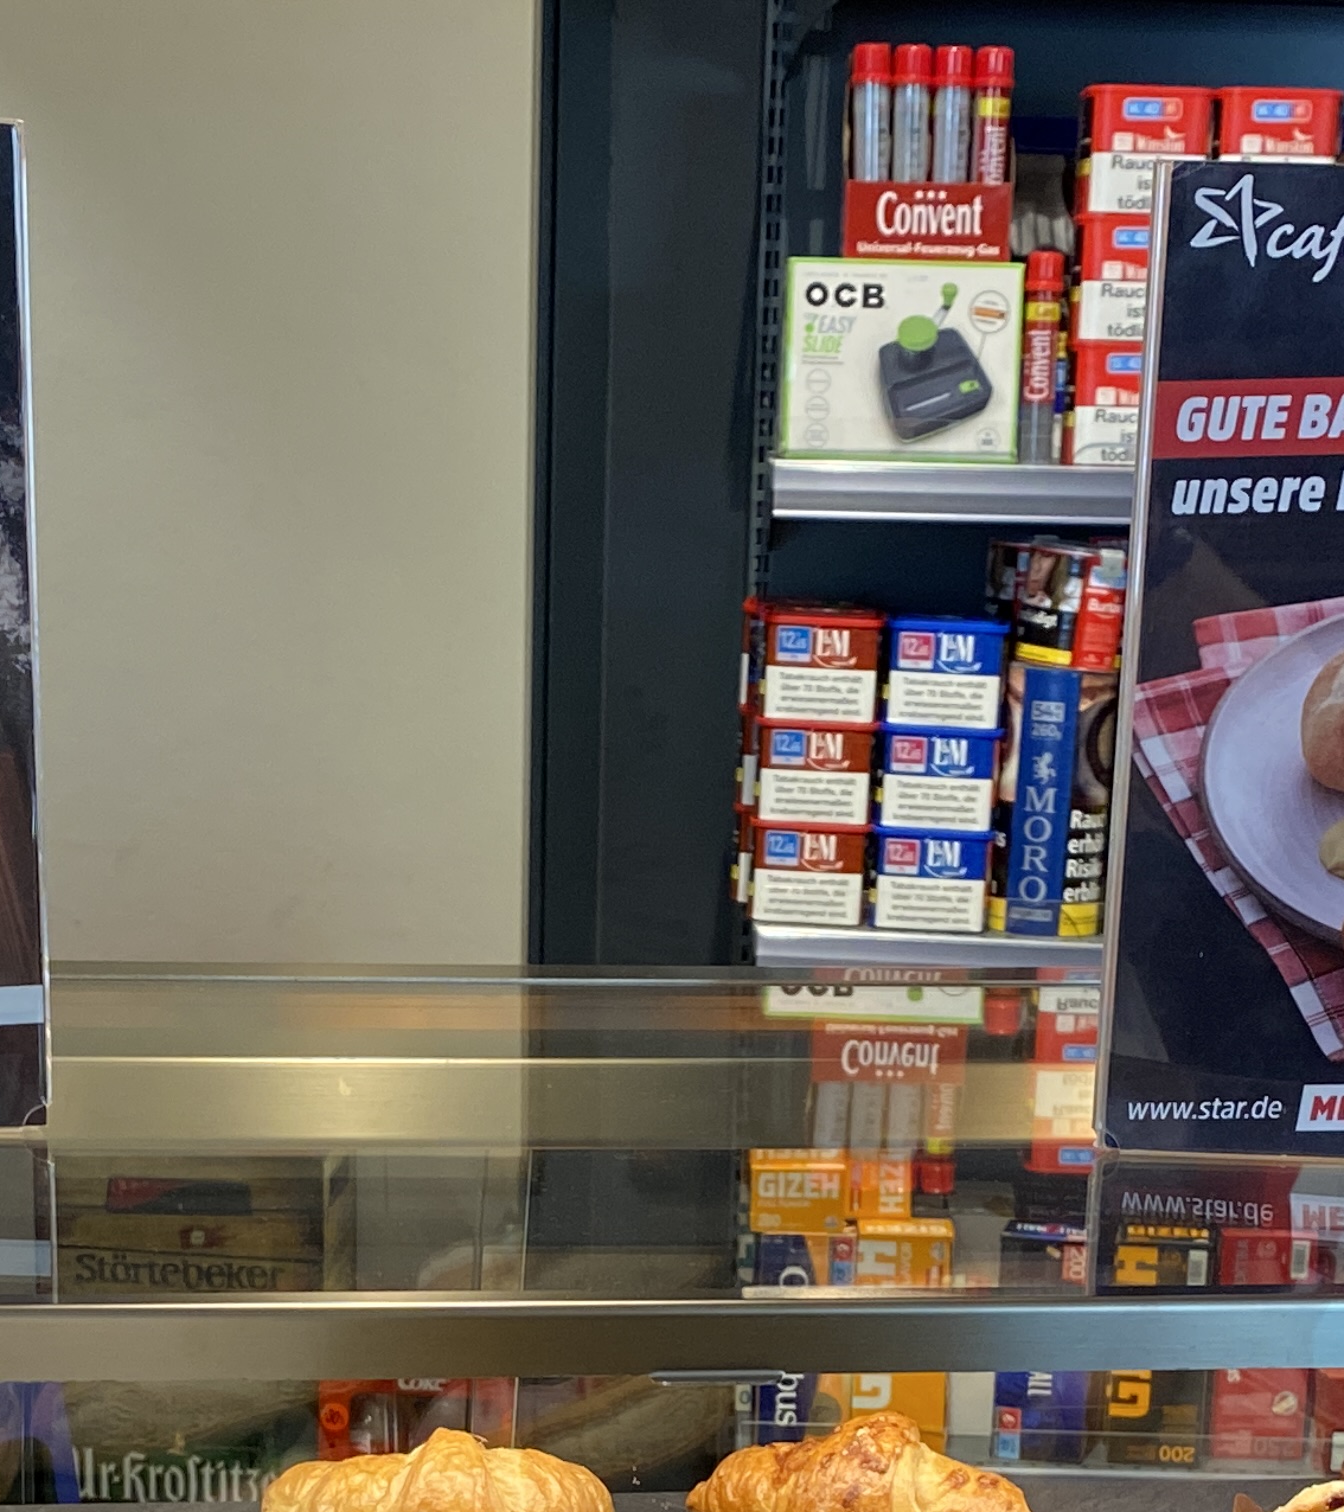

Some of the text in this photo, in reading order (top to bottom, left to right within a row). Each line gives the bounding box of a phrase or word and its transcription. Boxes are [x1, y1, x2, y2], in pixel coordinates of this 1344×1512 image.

[876, 189, 983, 237] Convent
[805, 281, 885, 309] OCB
[1023, 329, 1052, 401] Convent
[1175, 395, 1289, 444] GUTE
[1171, 474, 1325, 516] unsere
[1017, 785, 1058, 904] MORO
[1126, 1094, 1283, 1123] www.star.de
[758, 1171, 841, 1199] GIZEH
